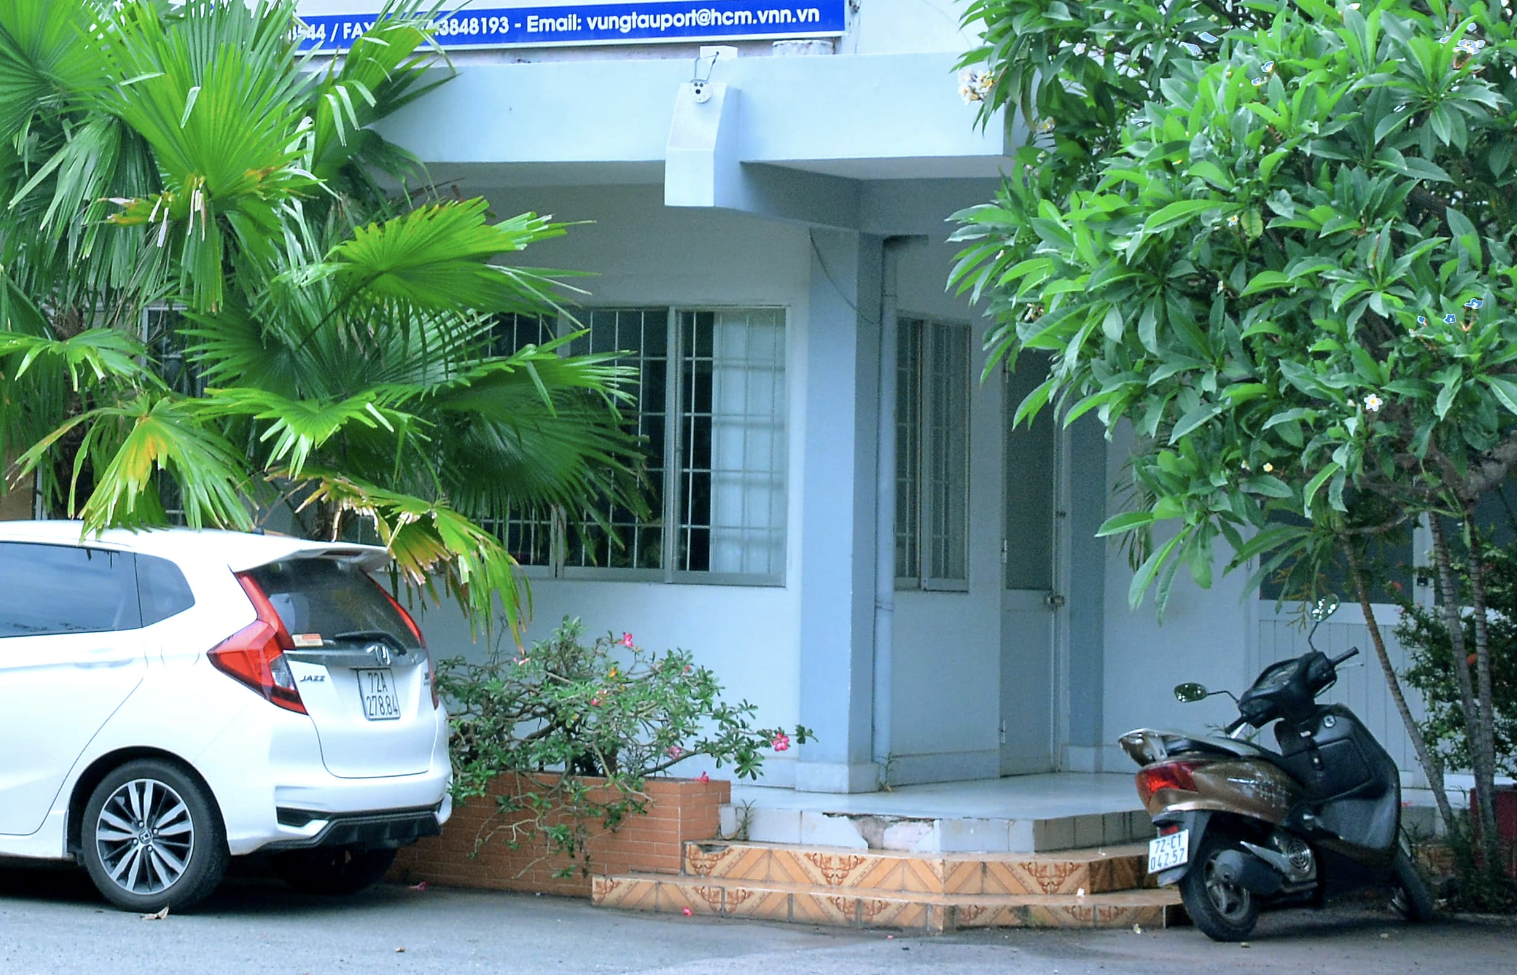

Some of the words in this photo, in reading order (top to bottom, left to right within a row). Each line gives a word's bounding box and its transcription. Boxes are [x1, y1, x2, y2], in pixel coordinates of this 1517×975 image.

[526, 14, 582, 33] Email:
[586, 8, 820, 34] vungtauport@hcm.vnn.vn
[300, 675, 326, 683] JAZZ
[367, 672, 388, 693] 72A
[366, 695, 398, 717] 278.84
